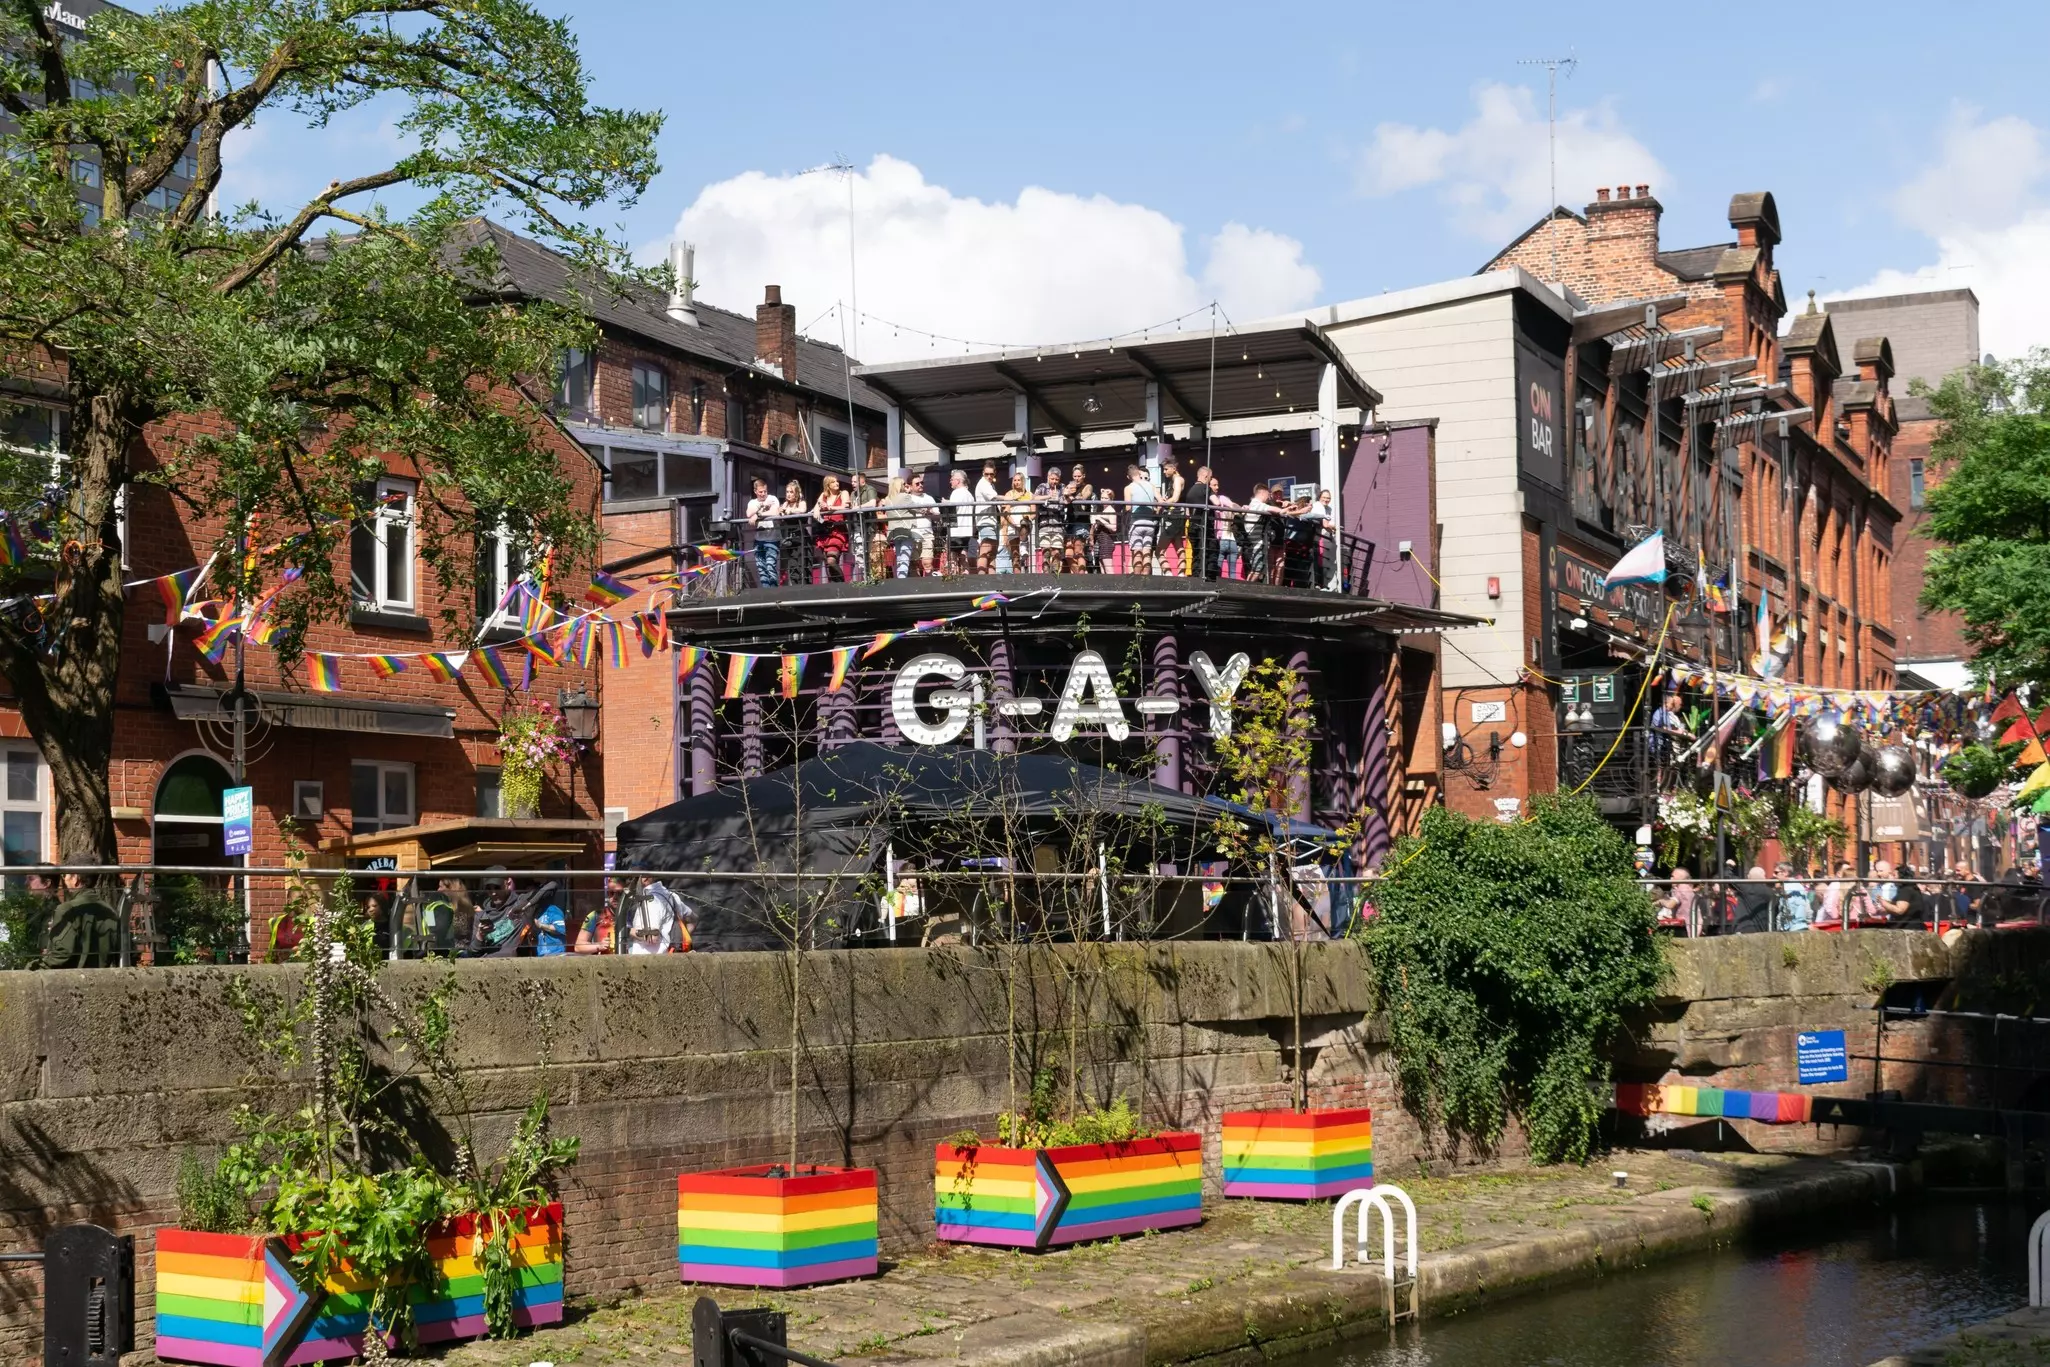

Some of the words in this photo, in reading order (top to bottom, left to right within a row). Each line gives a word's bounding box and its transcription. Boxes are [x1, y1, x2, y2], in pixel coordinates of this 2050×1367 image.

[1532, 418, 1552, 457] BAR
[892, 650, 1250, 745] G-A-Y
[293, 706, 334, 727] UNION
[339, 708, 378, 731] HOTEL
[224, 791, 249, 807] HAPPY
[225, 800, 249, 818] PRIDE
